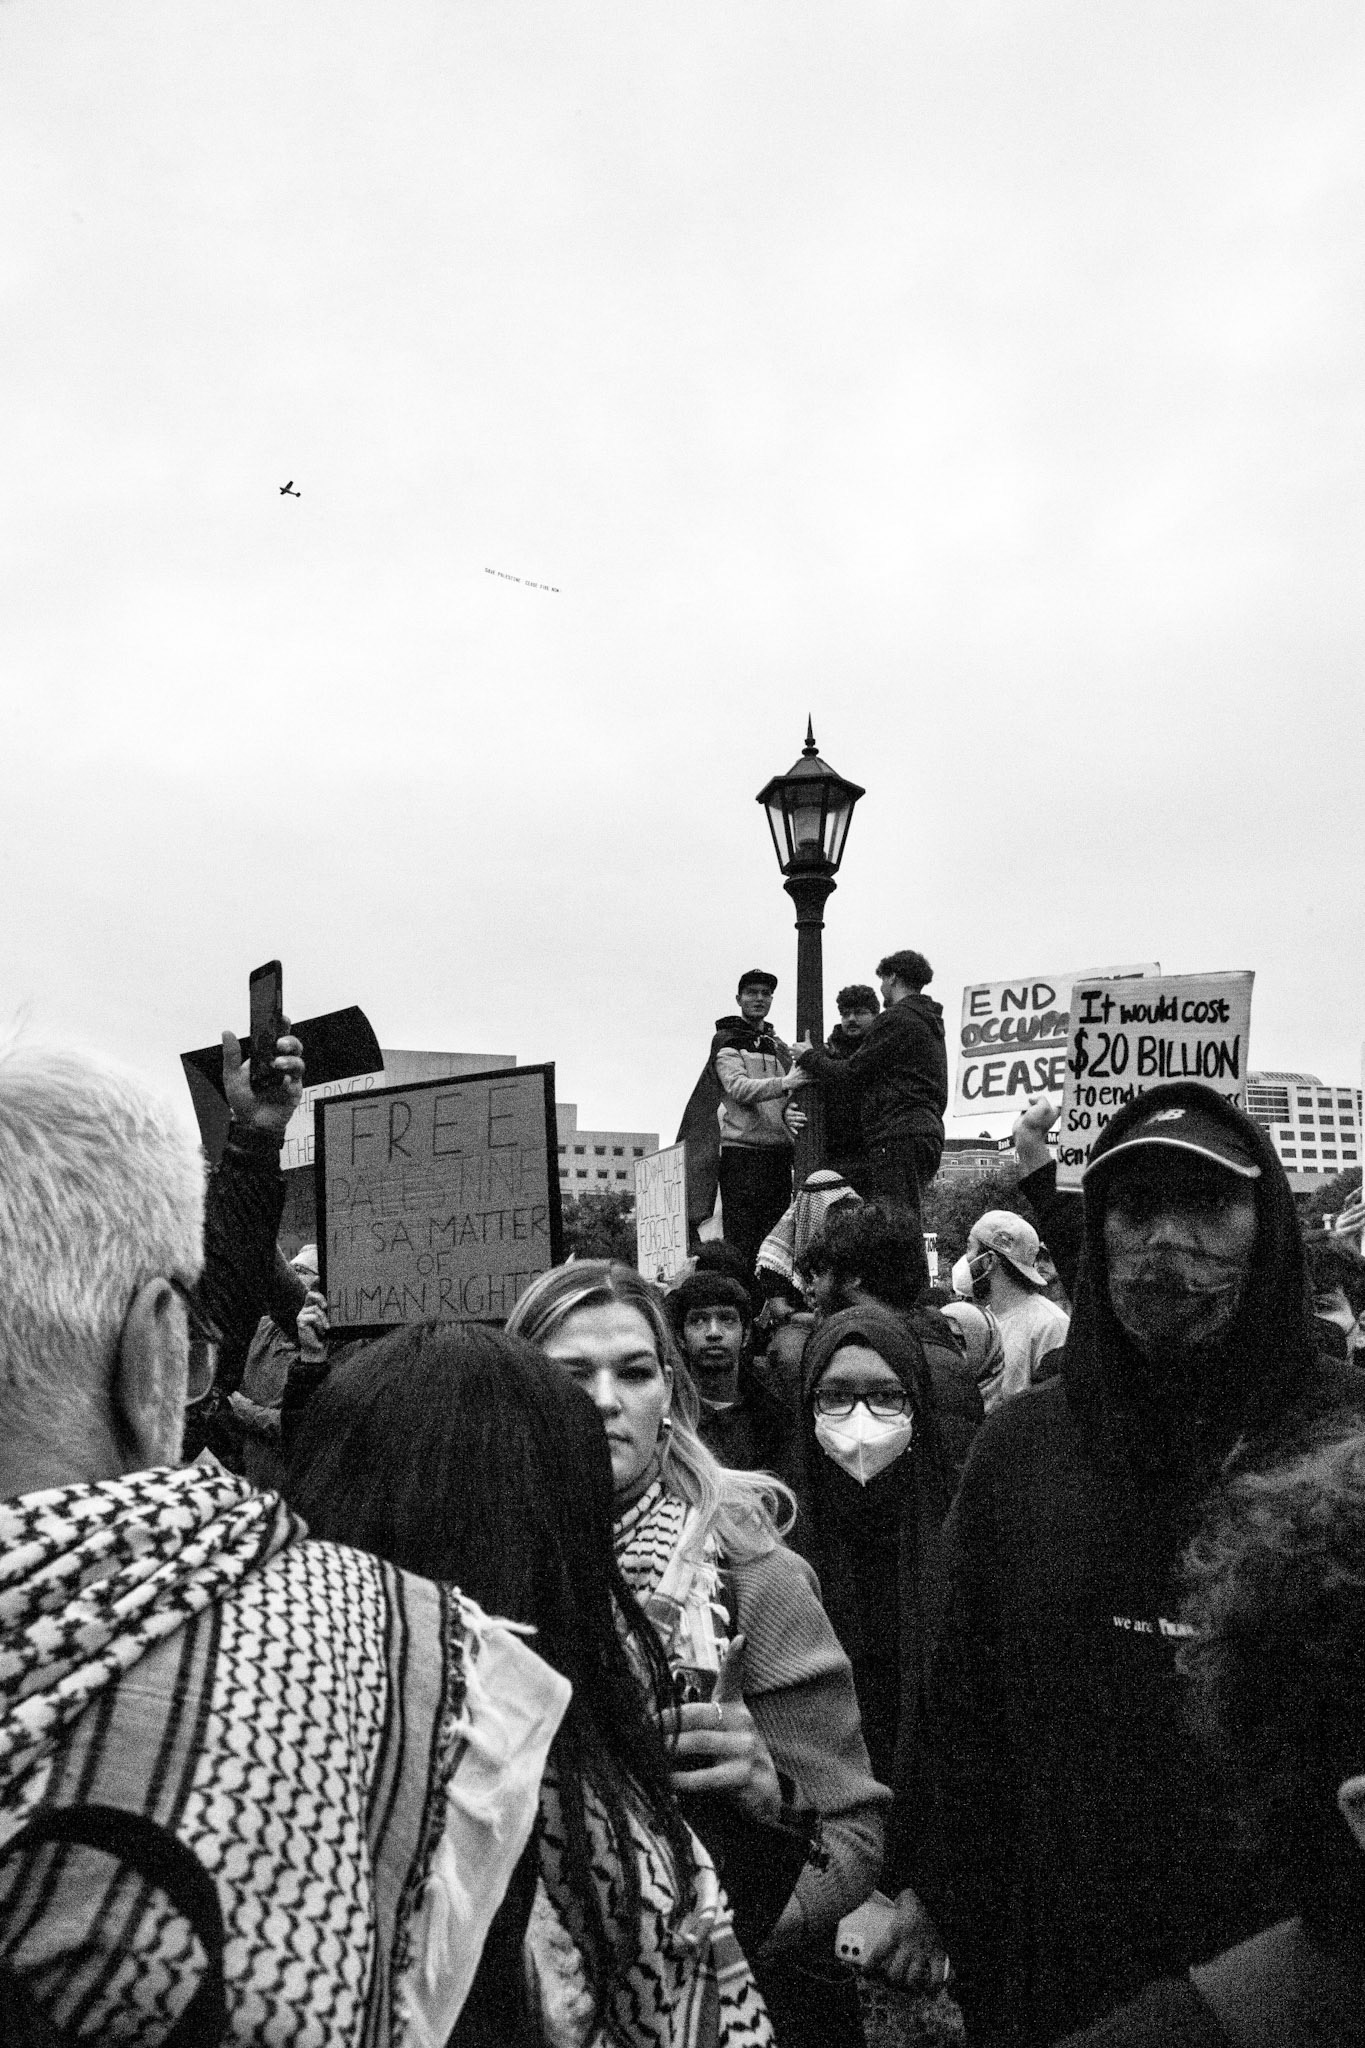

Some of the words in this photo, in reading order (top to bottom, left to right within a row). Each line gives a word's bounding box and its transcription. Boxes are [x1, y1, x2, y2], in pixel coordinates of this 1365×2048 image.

[497, 572, 520, 583] PALESTINE
[970, 983, 1056, 1017] END
[1079, 990, 1117, 1025] It
[1120, 994, 1177, 1023] would
[1181, 998, 1230, 1023] cost
[1067, 1028, 1128, 1080] $20
[1138, 1034, 1240, 1080] BILLION
[962, 1055, 1067, 1100] CEASE
[351, 1084, 518, 1165] FREE
[330, 1147, 546, 1217] PALESTINE
[429, 1203, 551, 1248] MATTER
[639, 1214, 681, 1253] FORGIVE
[416, 1250, 451, 1276] OF
[327, 1283, 426, 1327] HUMAN
[1113, 1615, 1132, 1630] we
